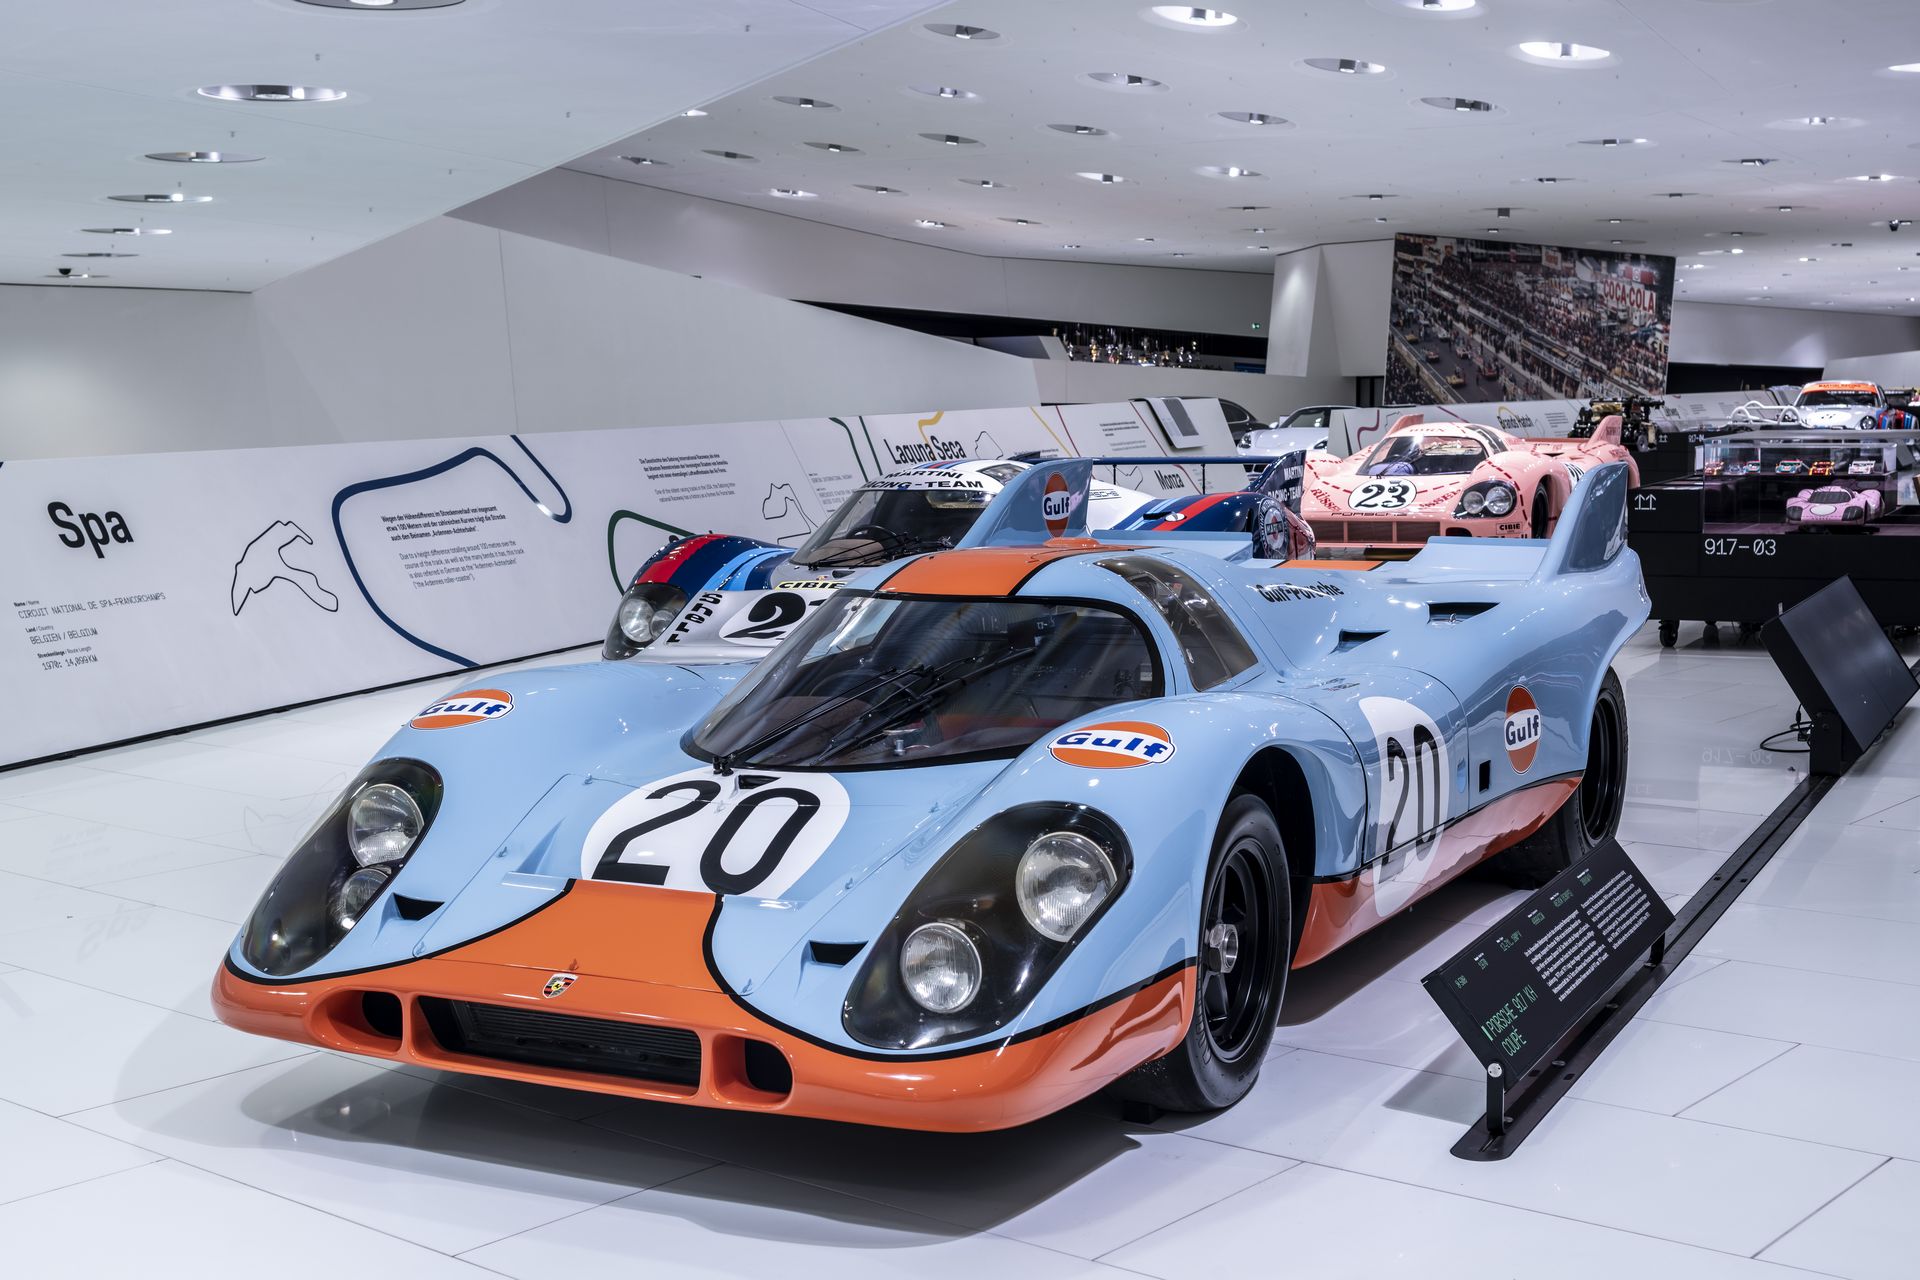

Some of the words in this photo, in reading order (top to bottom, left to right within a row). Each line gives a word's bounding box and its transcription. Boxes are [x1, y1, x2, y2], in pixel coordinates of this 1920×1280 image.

[883, 439, 937, 465] Laguna
[930, 435, 967, 461] Seca
[884, 470, 964, 479] MARTINI
[1154, 470, 1185, 491] Monza
[1044, 497, 1071, 516] Gulf
[1354, 481, 1410, 509] 23
[47, 501, 134, 559] Spa
[1704, 538, 1777, 556] 917-03
[18, 607, 49, 620] CIRCUIT
[52, 603, 87, 616] NATIONAL
[88, 600, 99, 611] DE
[99, 592, 167, 609] SPA-FRANCORCHAMPS
[30, 633, 63, 646] BELGIEN
[67, 627, 99, 640] BELGIUM
[42, 659, 64, 672] 1970:
[419, 702, 508, 717] Gulf
[1506, 715, 1541, 746] Gulf
[1056, 732, 1169, 758] Gulf
[1378, 723, 1441, 885] 20
[593, 779, 822, 896] 20
[1486, 1003, 1518, 1038] PORSCHE
[1512, 992, 1529, 1013] 917
[1522, 984, 1539, 1004] KH
[1501, 1025, 1527, 1057] COUPÉ
